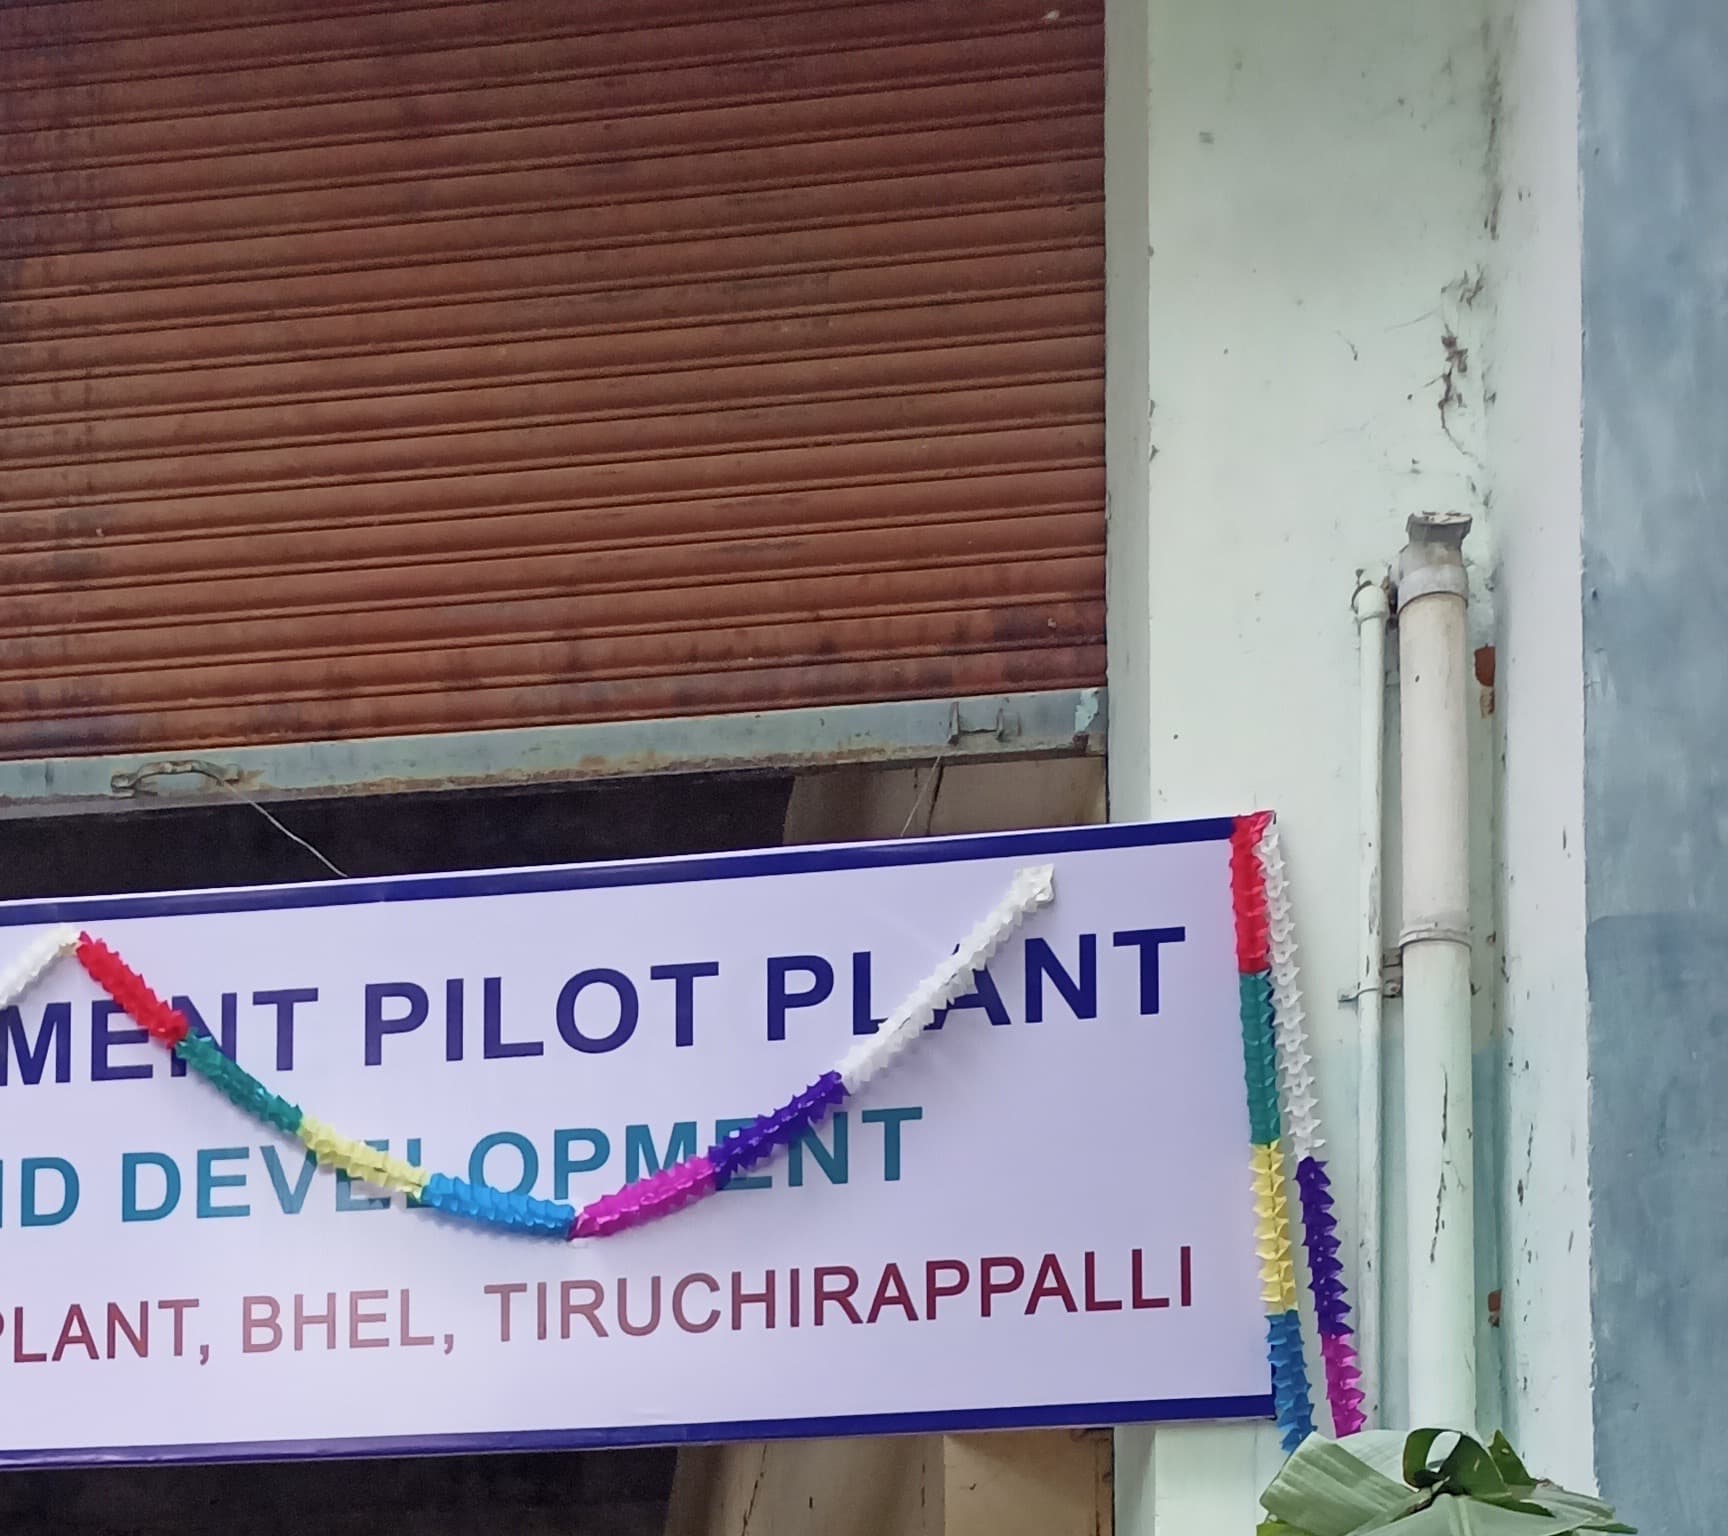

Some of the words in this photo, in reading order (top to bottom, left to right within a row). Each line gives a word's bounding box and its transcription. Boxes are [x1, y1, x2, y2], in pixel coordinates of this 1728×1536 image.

[364, 961, 719, 1067] PILOT
[767, 926, 1186, 1040] PLANT
[241, 1287, 456, 1355] BHEL,
[483, 1245, 1194, 1342] TIRUCHIRAPPALLI
